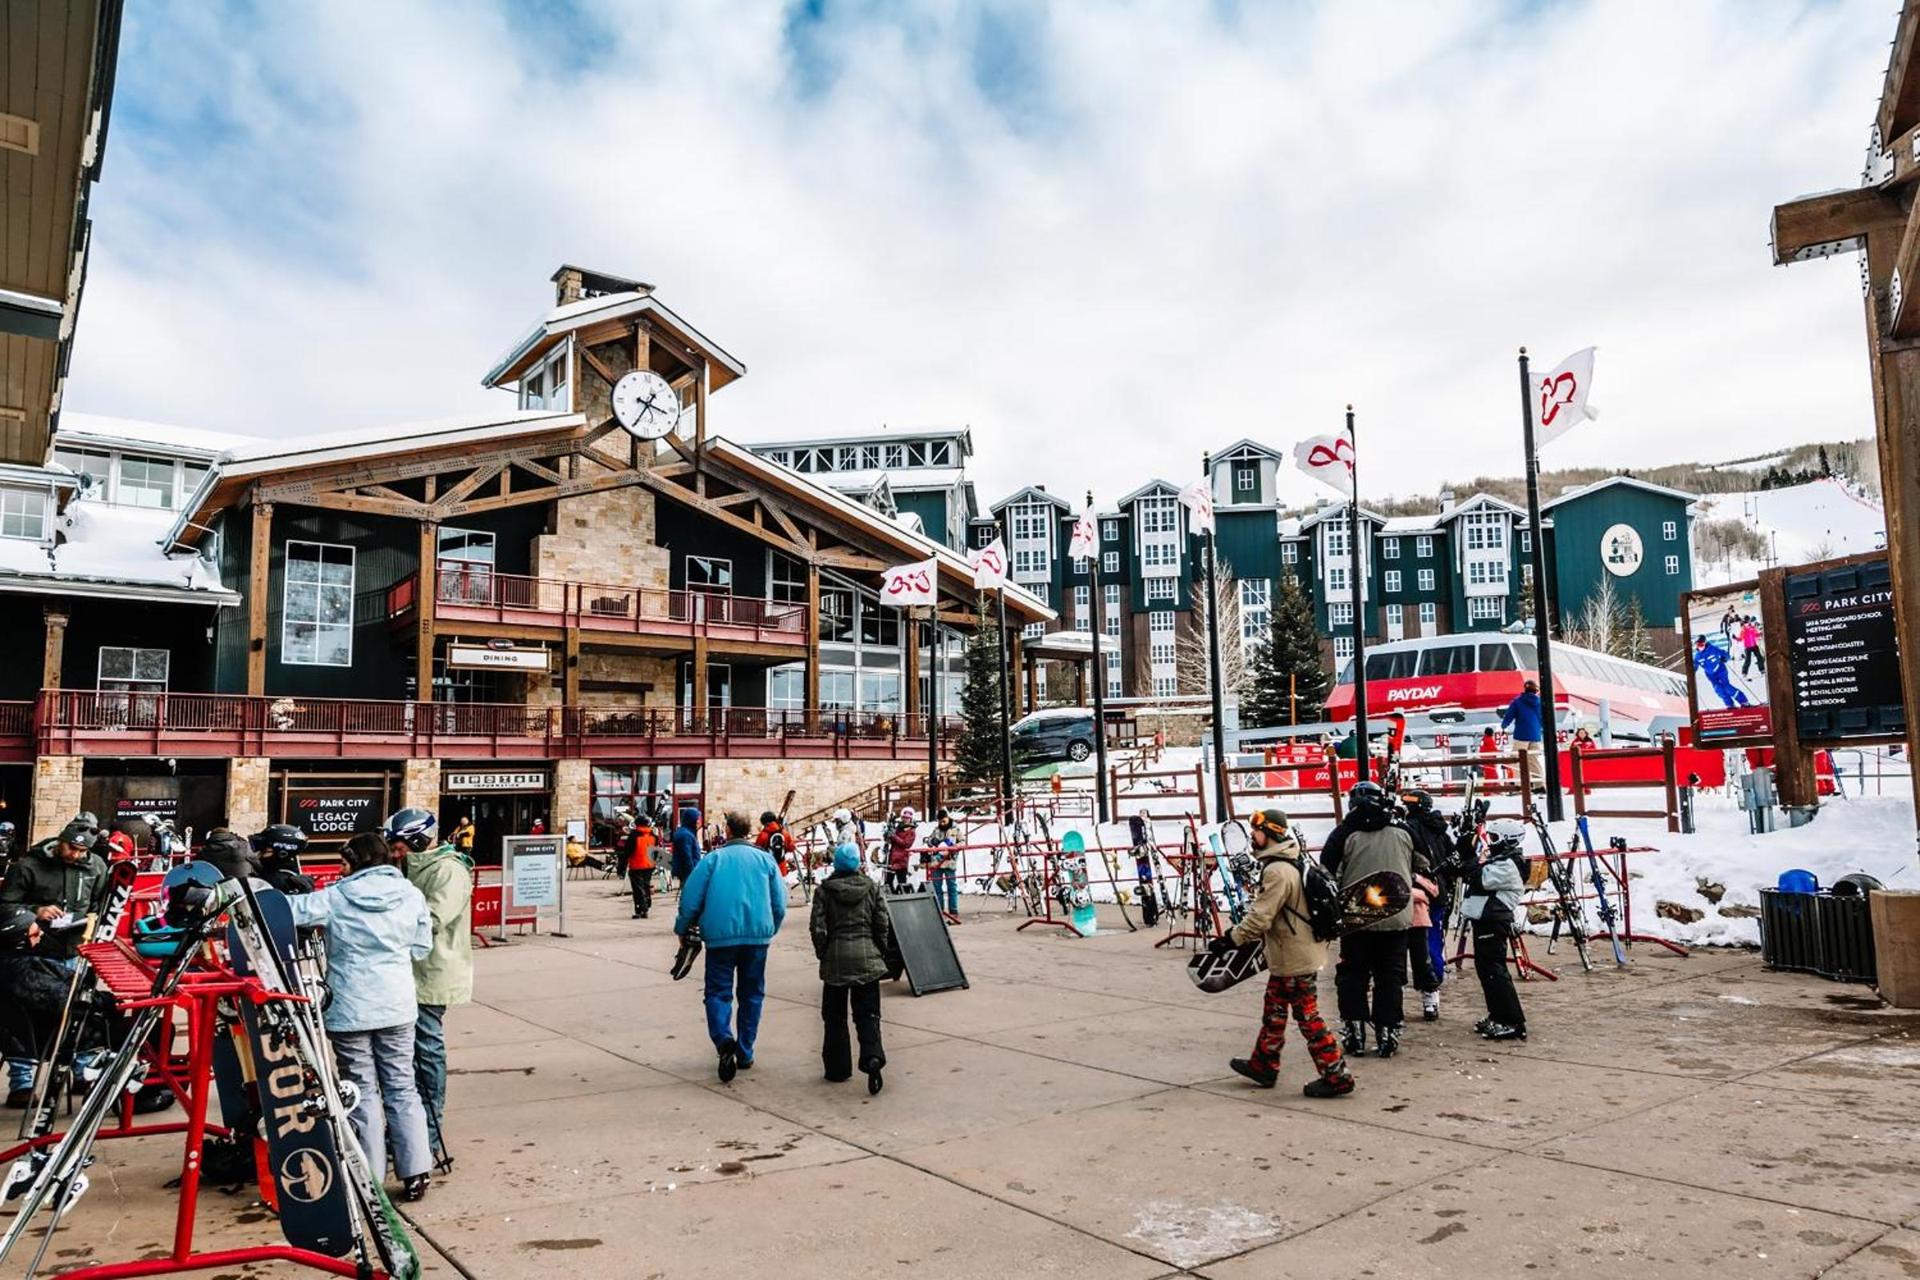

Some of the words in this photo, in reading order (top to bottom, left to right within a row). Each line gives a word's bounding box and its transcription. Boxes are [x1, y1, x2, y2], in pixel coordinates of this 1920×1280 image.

[1826, 597, 1858, 609] PARK
[1862, 592, 1892, 603] CITY
[483, 654, 518, 663] DINING
[1387, 686, 1443, 702] PAYDAY
[1338, 771, 1355, 779] ARK
[320, 799, 345, 807] PARK
[346, 799, 370, 807] CITY
[310, 812, 358, 822] LEGACY
[313, 822, 355, 832] LODGE
[475, 901, 500, 911] CIT
[96, 884, 134, 942] ÖLKL
